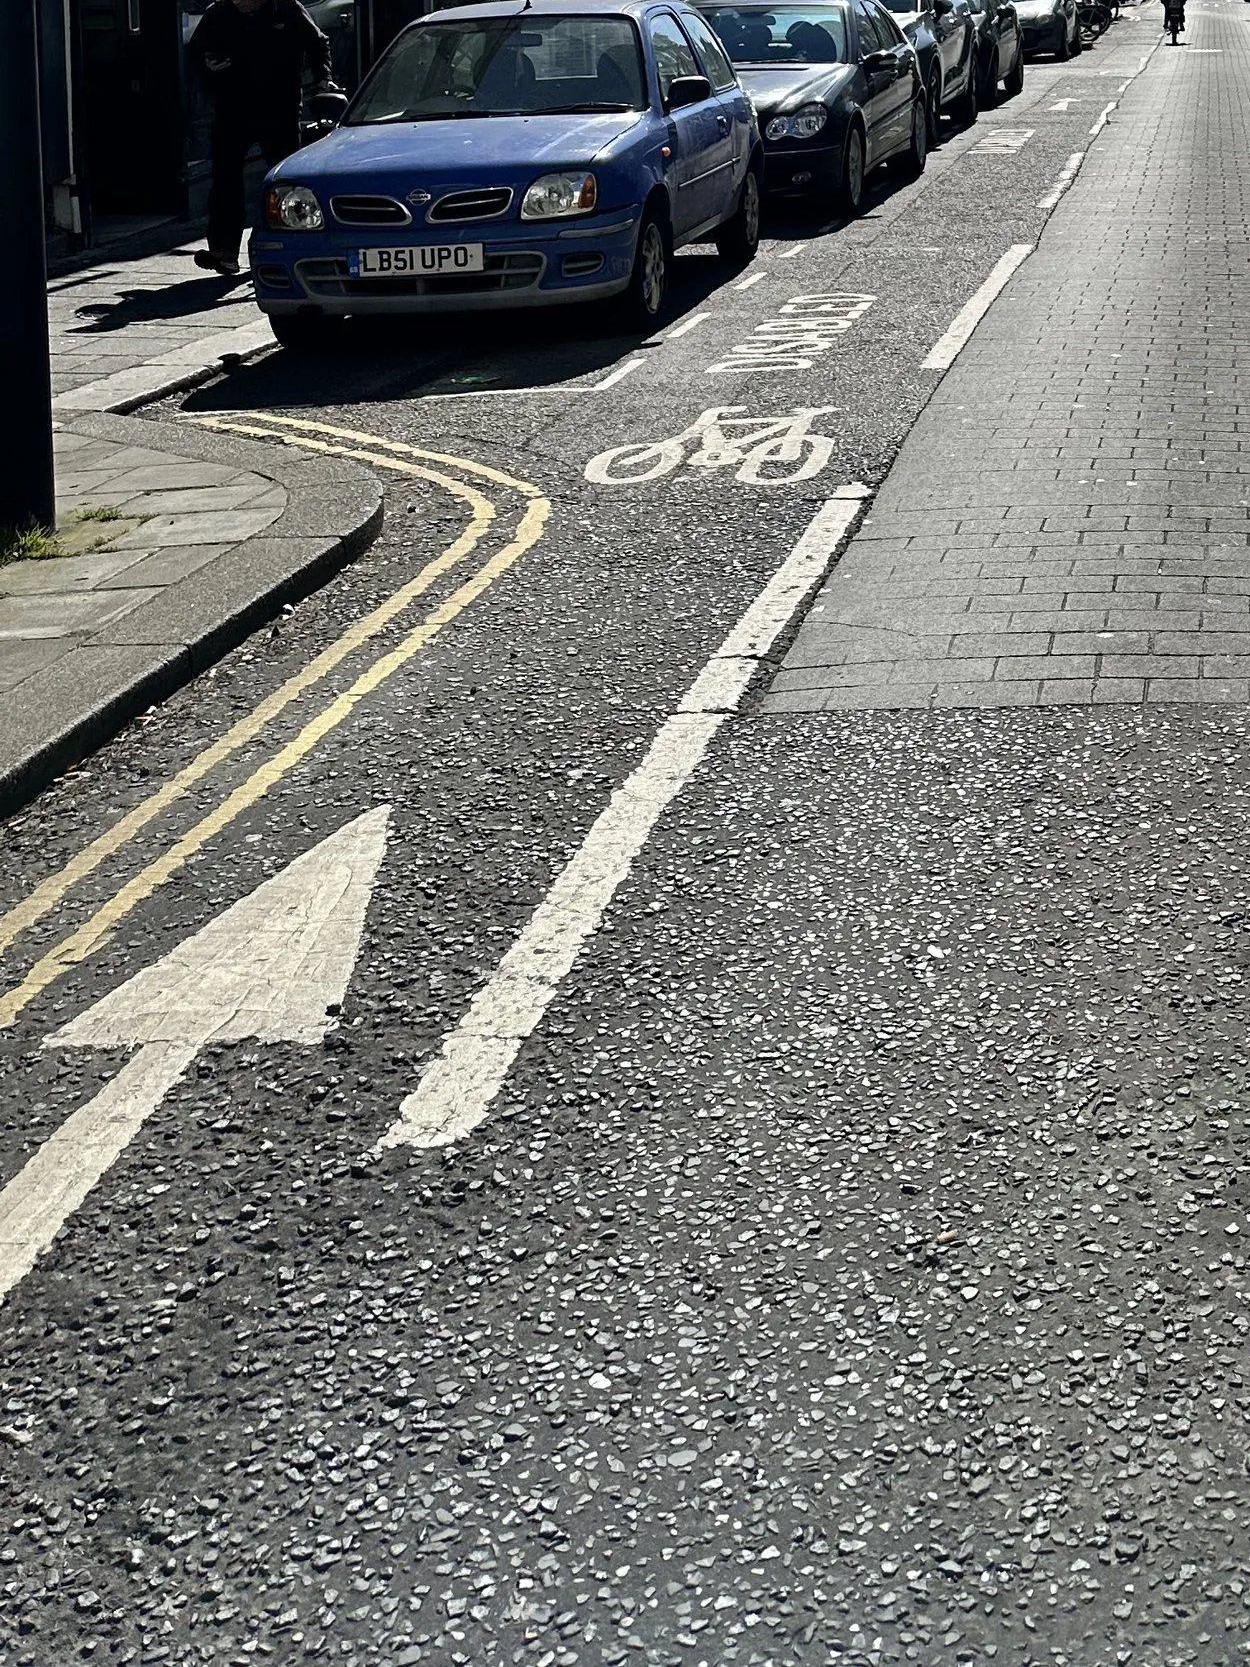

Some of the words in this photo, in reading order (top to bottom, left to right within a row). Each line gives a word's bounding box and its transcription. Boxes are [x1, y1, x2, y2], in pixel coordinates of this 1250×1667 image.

[362, 249, 415, 273] LB51
[421, 246, 468, 269] UPO
[704, 292, 877, 373] DISABLED
